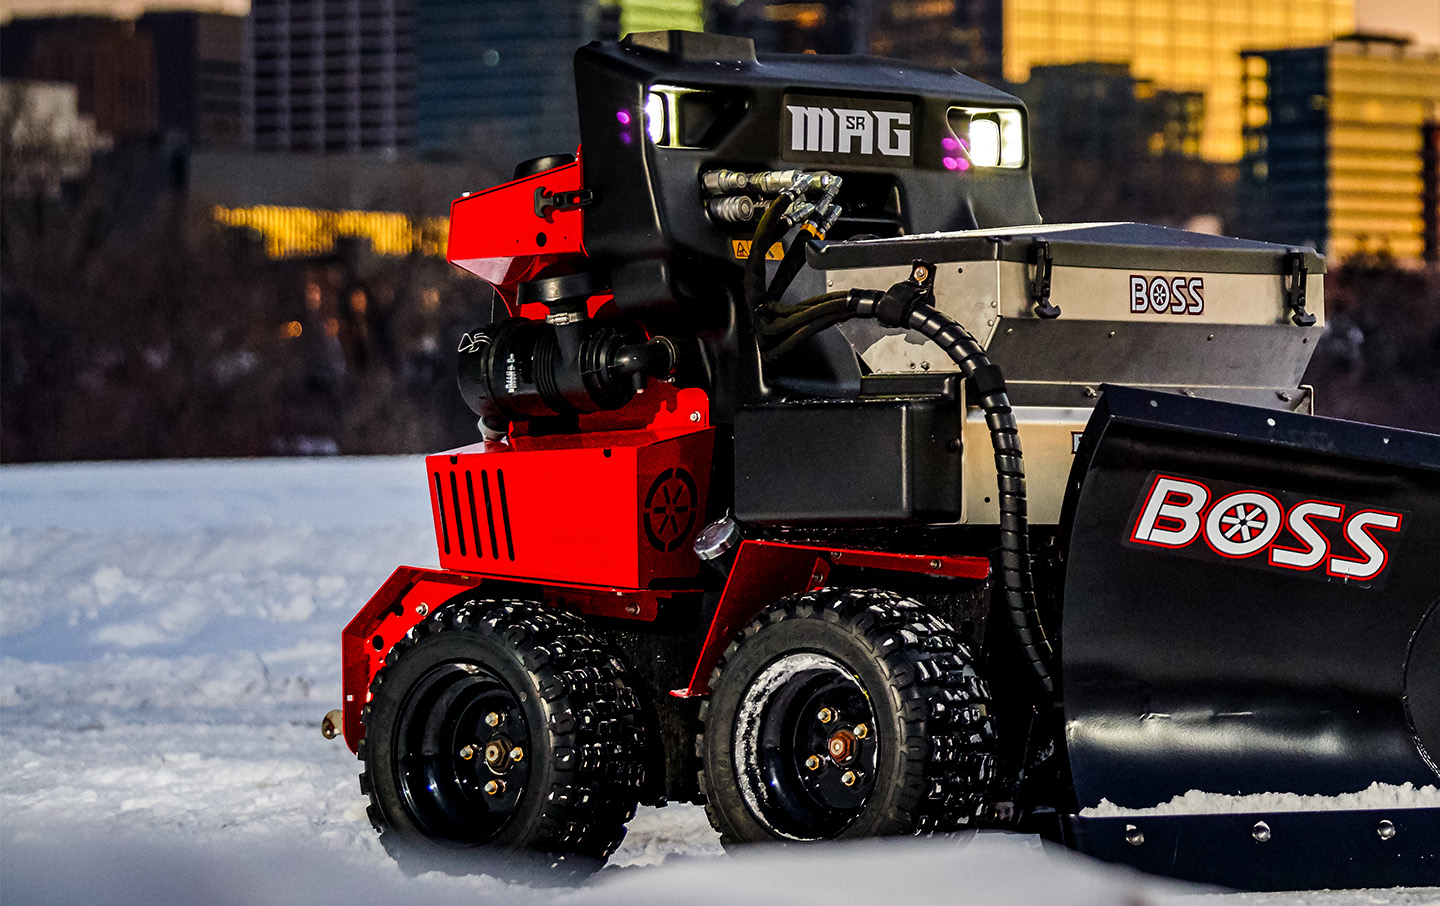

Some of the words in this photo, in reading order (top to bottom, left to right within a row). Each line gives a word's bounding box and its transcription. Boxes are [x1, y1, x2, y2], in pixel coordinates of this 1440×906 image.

[786, 105, 910, 156] MAG
[846, 115, 865, 130] SR
[1129, 275, 1204, 315] BOSS
[1130, 474, 1403, 581] BOSS
